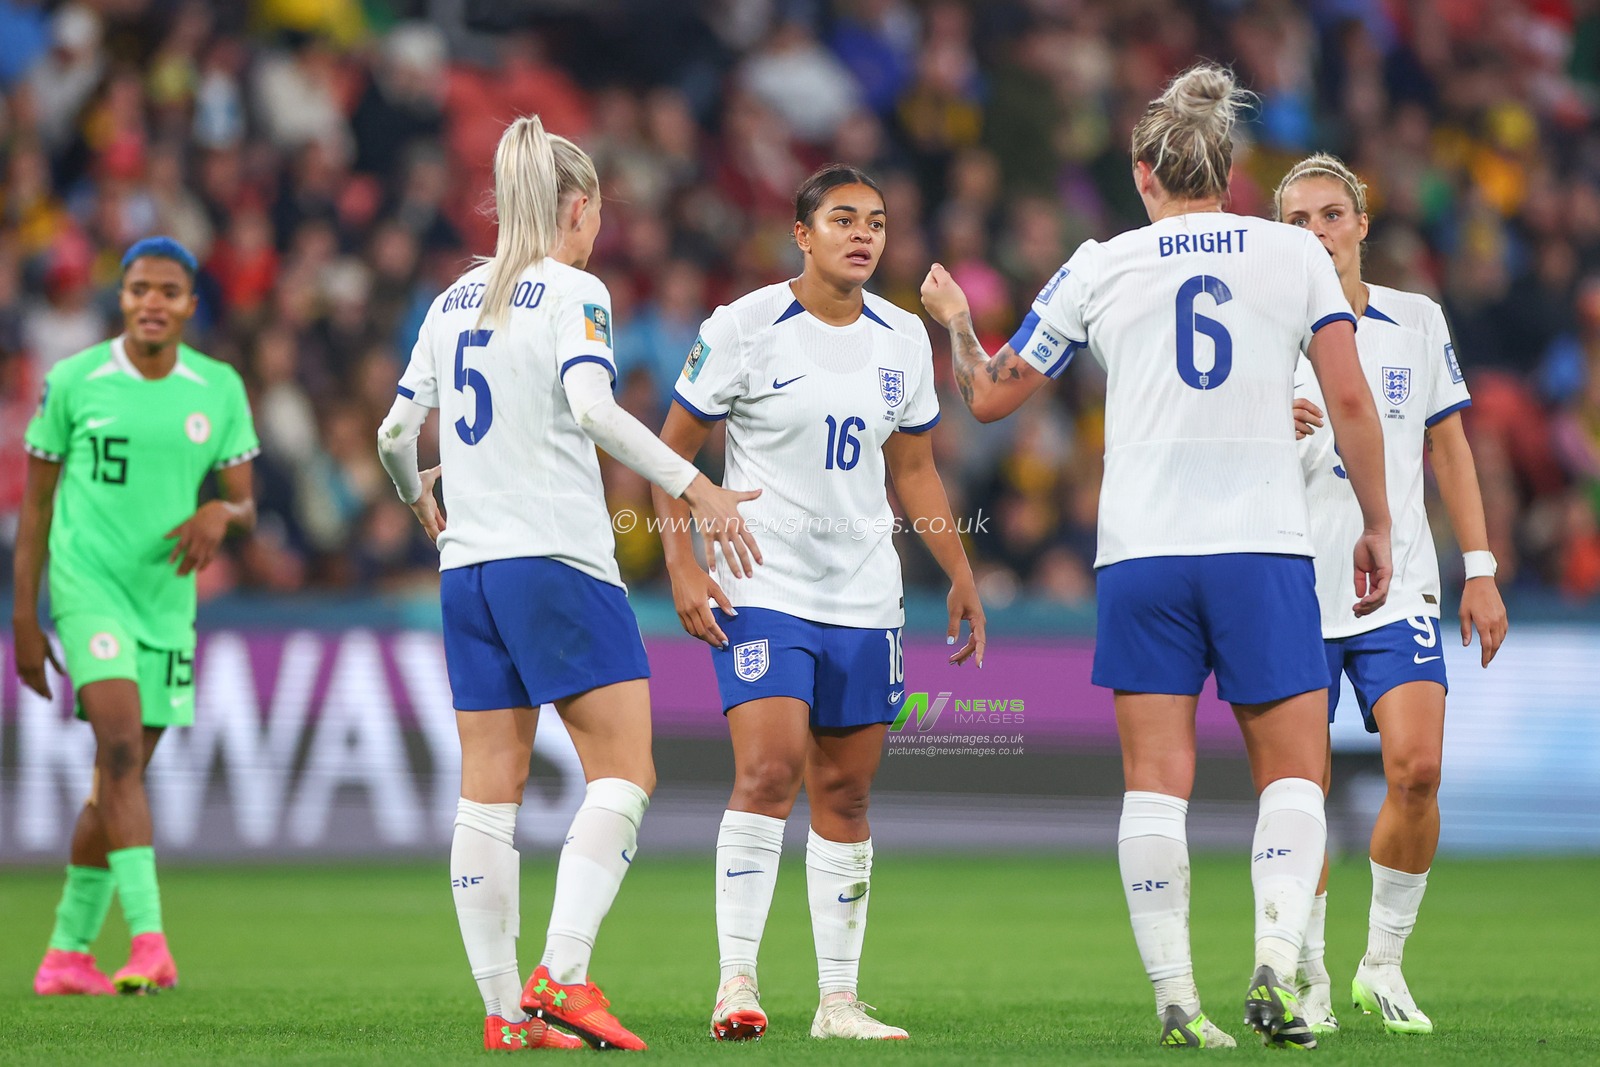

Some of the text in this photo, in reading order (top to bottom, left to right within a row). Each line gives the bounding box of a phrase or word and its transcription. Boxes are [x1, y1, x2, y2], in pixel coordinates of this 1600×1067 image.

[1158, 229, 1248, 258] BRIGHT
[442, 280, 546, 314] GREEOD
[1175, 274, 1233, 391] 6
[454, 329, 495, 446] 5
[89, 436, 129, 485] 15
[824, 414, 866, 471] 16
[165, 651, 193, 687] 15
[886, 628, 904, 685] 16
